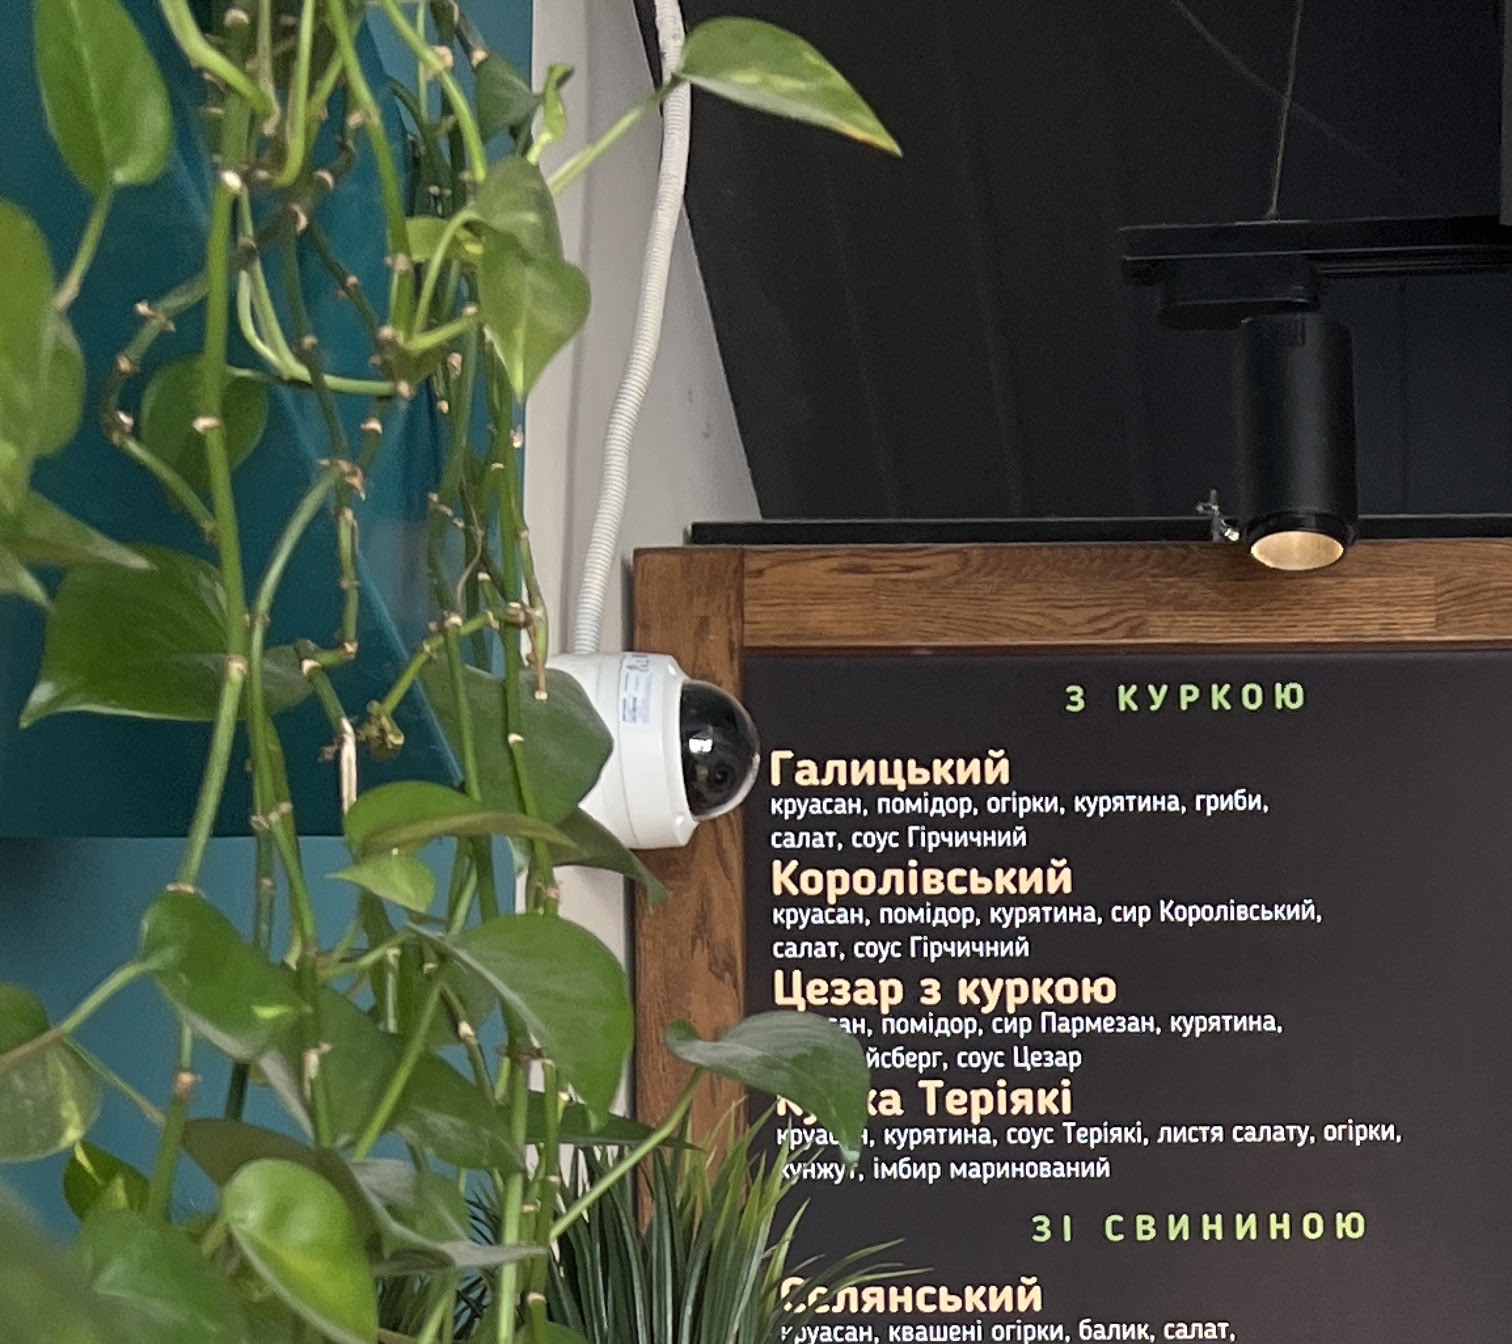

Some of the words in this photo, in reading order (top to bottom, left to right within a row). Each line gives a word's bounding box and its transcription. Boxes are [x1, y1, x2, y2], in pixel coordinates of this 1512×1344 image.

[1065, 684, 1085, 713] З
[1118, 682, 1304, 712] КУРКОЮ
[769, 749, 1011, 793] Галицький
[770, 797, 869, 821] круасан,
[877, 791, 979, 819] помідор,
[986, 790, 1066, 819] огірки,
[1073, 793, 1187, 818] курятина,
[1195, 788, 1269, 817] гриби,
[772, 857, 1073, 906] Королівський
[774, 969, 904, 1015] Цезар
[919, 977, 942, 1006] з
[958, 976, 1117, 1015] куркою
[881, 1011, 984, 1040] помідор,
[991, 1016, 1033, 1039] сир
[1040, 1011, 1162, 1039] Пармезан,
[1170, 1014, 1283, 1038] курятина,
[917, 1078, 1072, 1126] Теріякі
[884, 1127, 998, 1151] курятина,
[1006, 1126, 1055, 1150] соус
[1061, 1120, 1149, 1150] Теріякі,
[1156, 1125, 1224, 1144] листя
[1232, 1124, 1315, 1148] салату,
[1323, 1118, 1402, 1147] огірки,
[1031, 1214, 1072, 1243] ЗІ
[1105, 1211, 1365, 1242] СВИНИНОЮ
